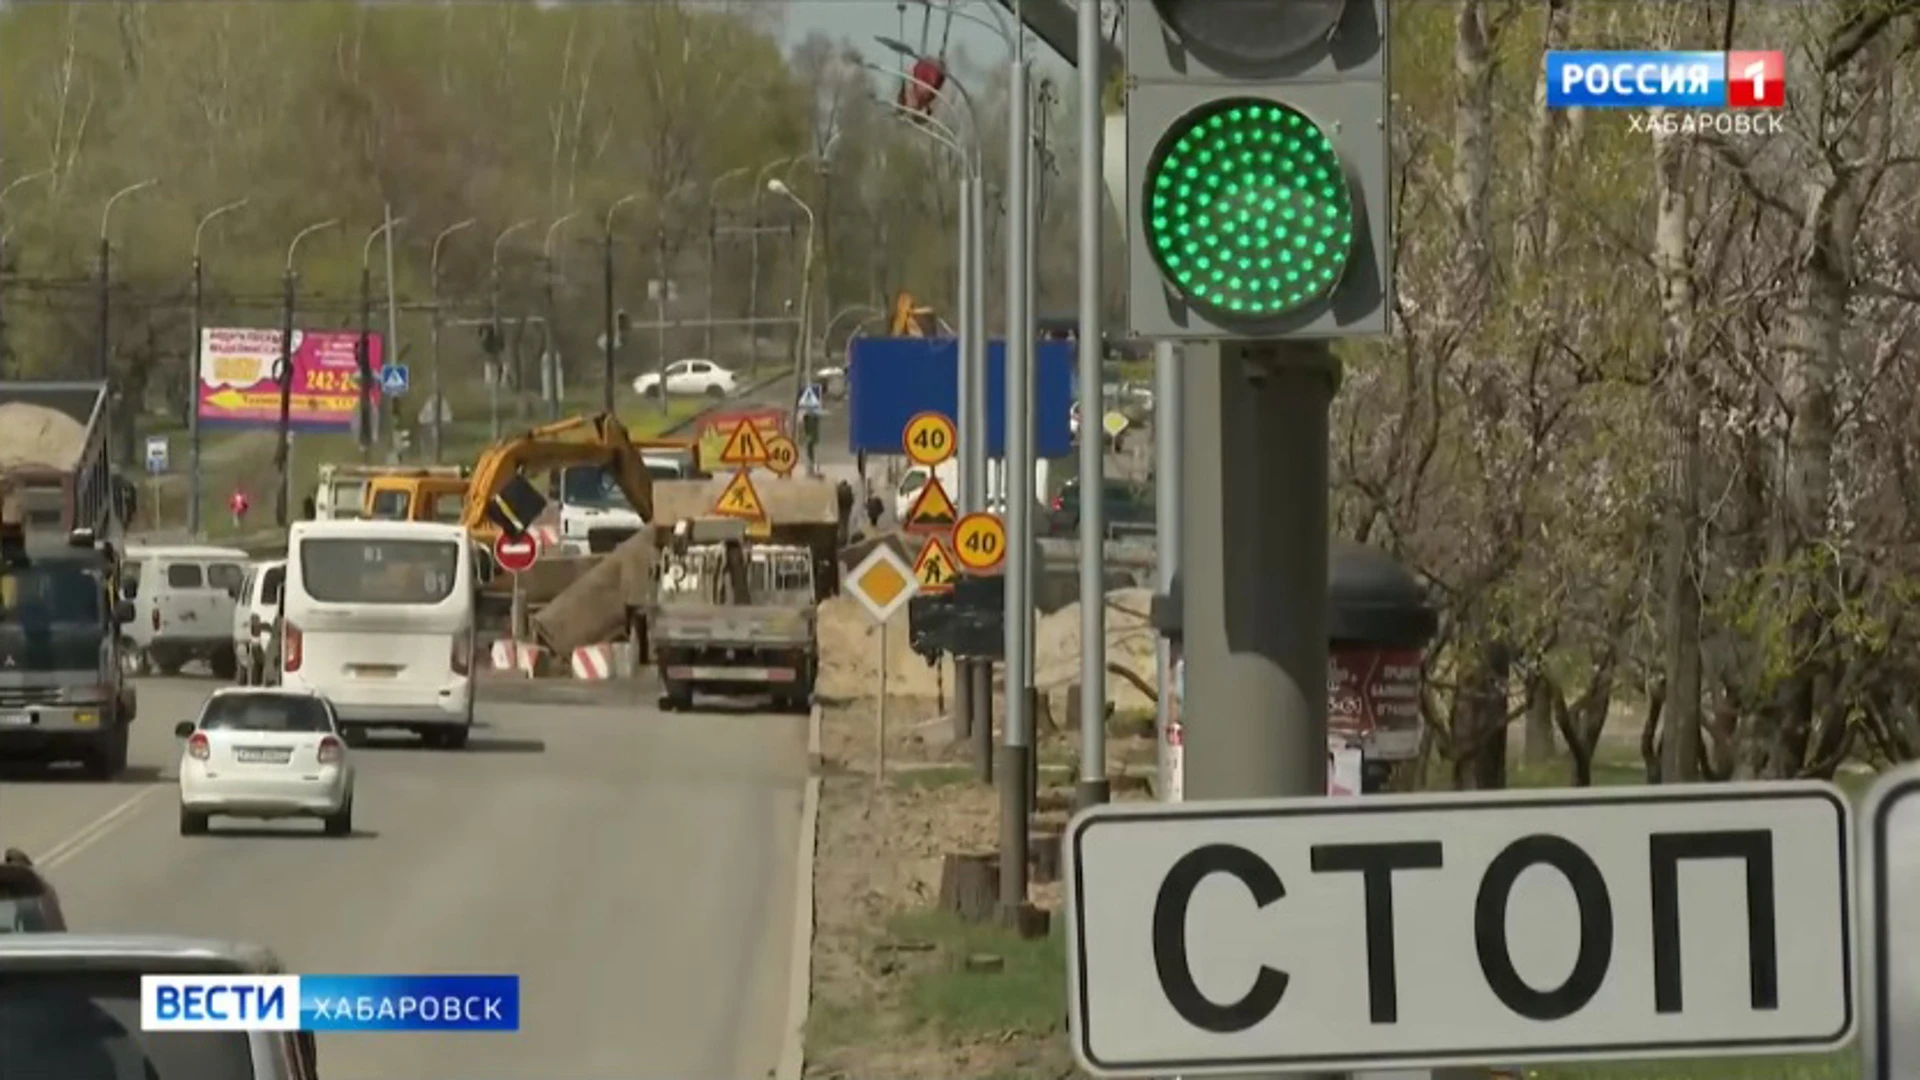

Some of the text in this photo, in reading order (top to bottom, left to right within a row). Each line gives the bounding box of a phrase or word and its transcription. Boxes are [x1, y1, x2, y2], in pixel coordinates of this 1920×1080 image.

[913, 428, 945, 450] 40
[771, 447, 790, 463] 40
[964, 530, 997, 554] 40
[1152, 829, 1779, 1033] СТОП
